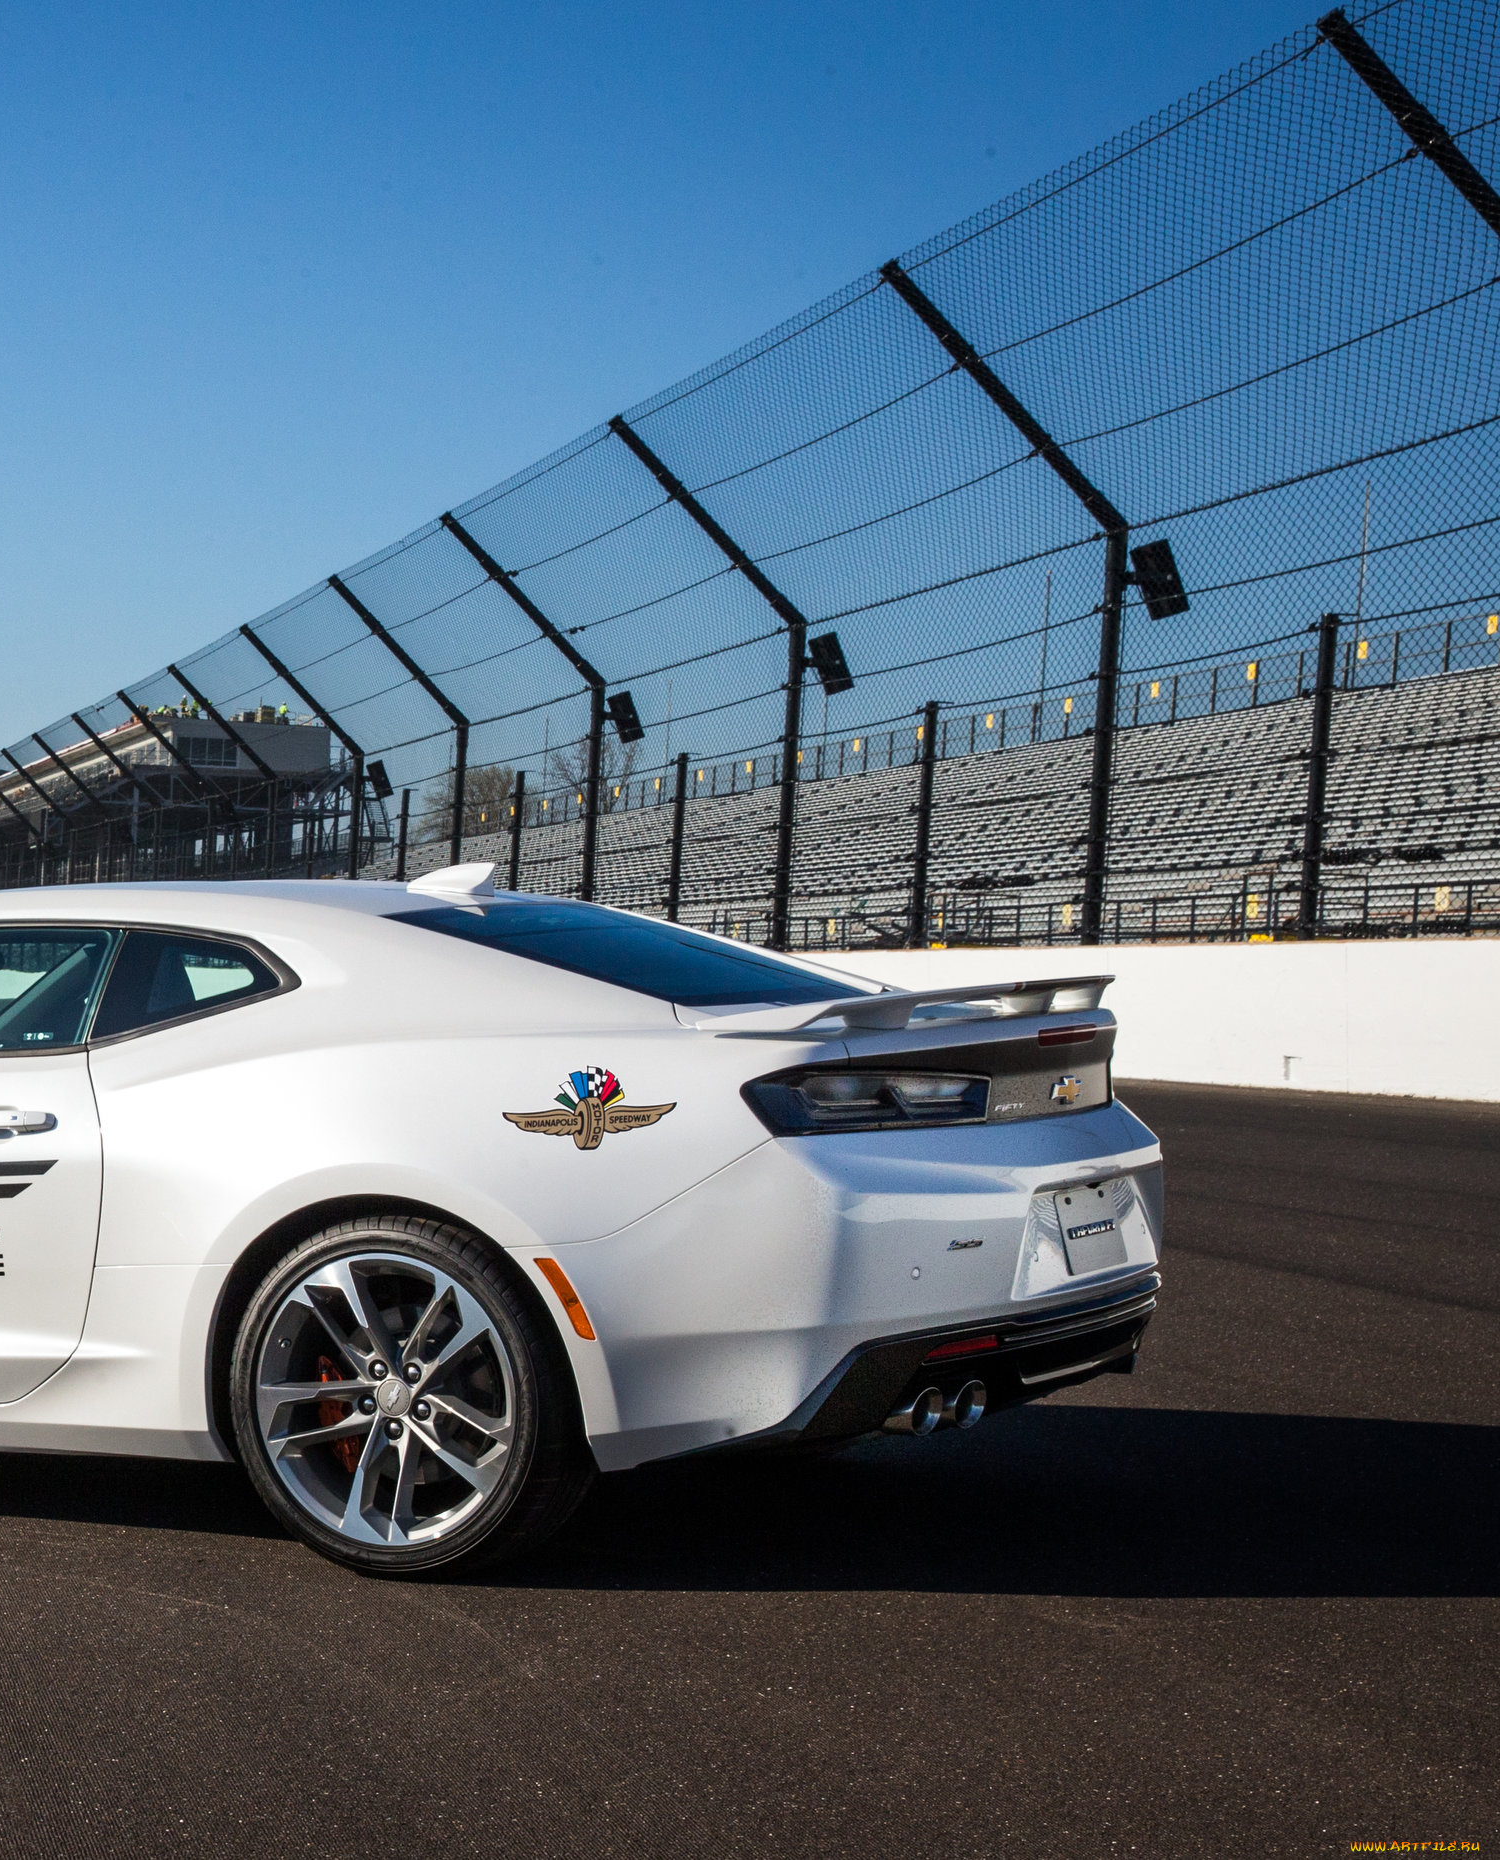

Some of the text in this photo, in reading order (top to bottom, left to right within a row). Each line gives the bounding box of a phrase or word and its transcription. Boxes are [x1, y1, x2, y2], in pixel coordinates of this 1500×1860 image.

[994, 1102, 1026, 1112] FIFTY
[524, 1117, 579, 1128] INDIANAPOLIS
[590, 1103, 603, 1143] MOTOR
[609, 1114, 652, 1124] SPEEDWAY
